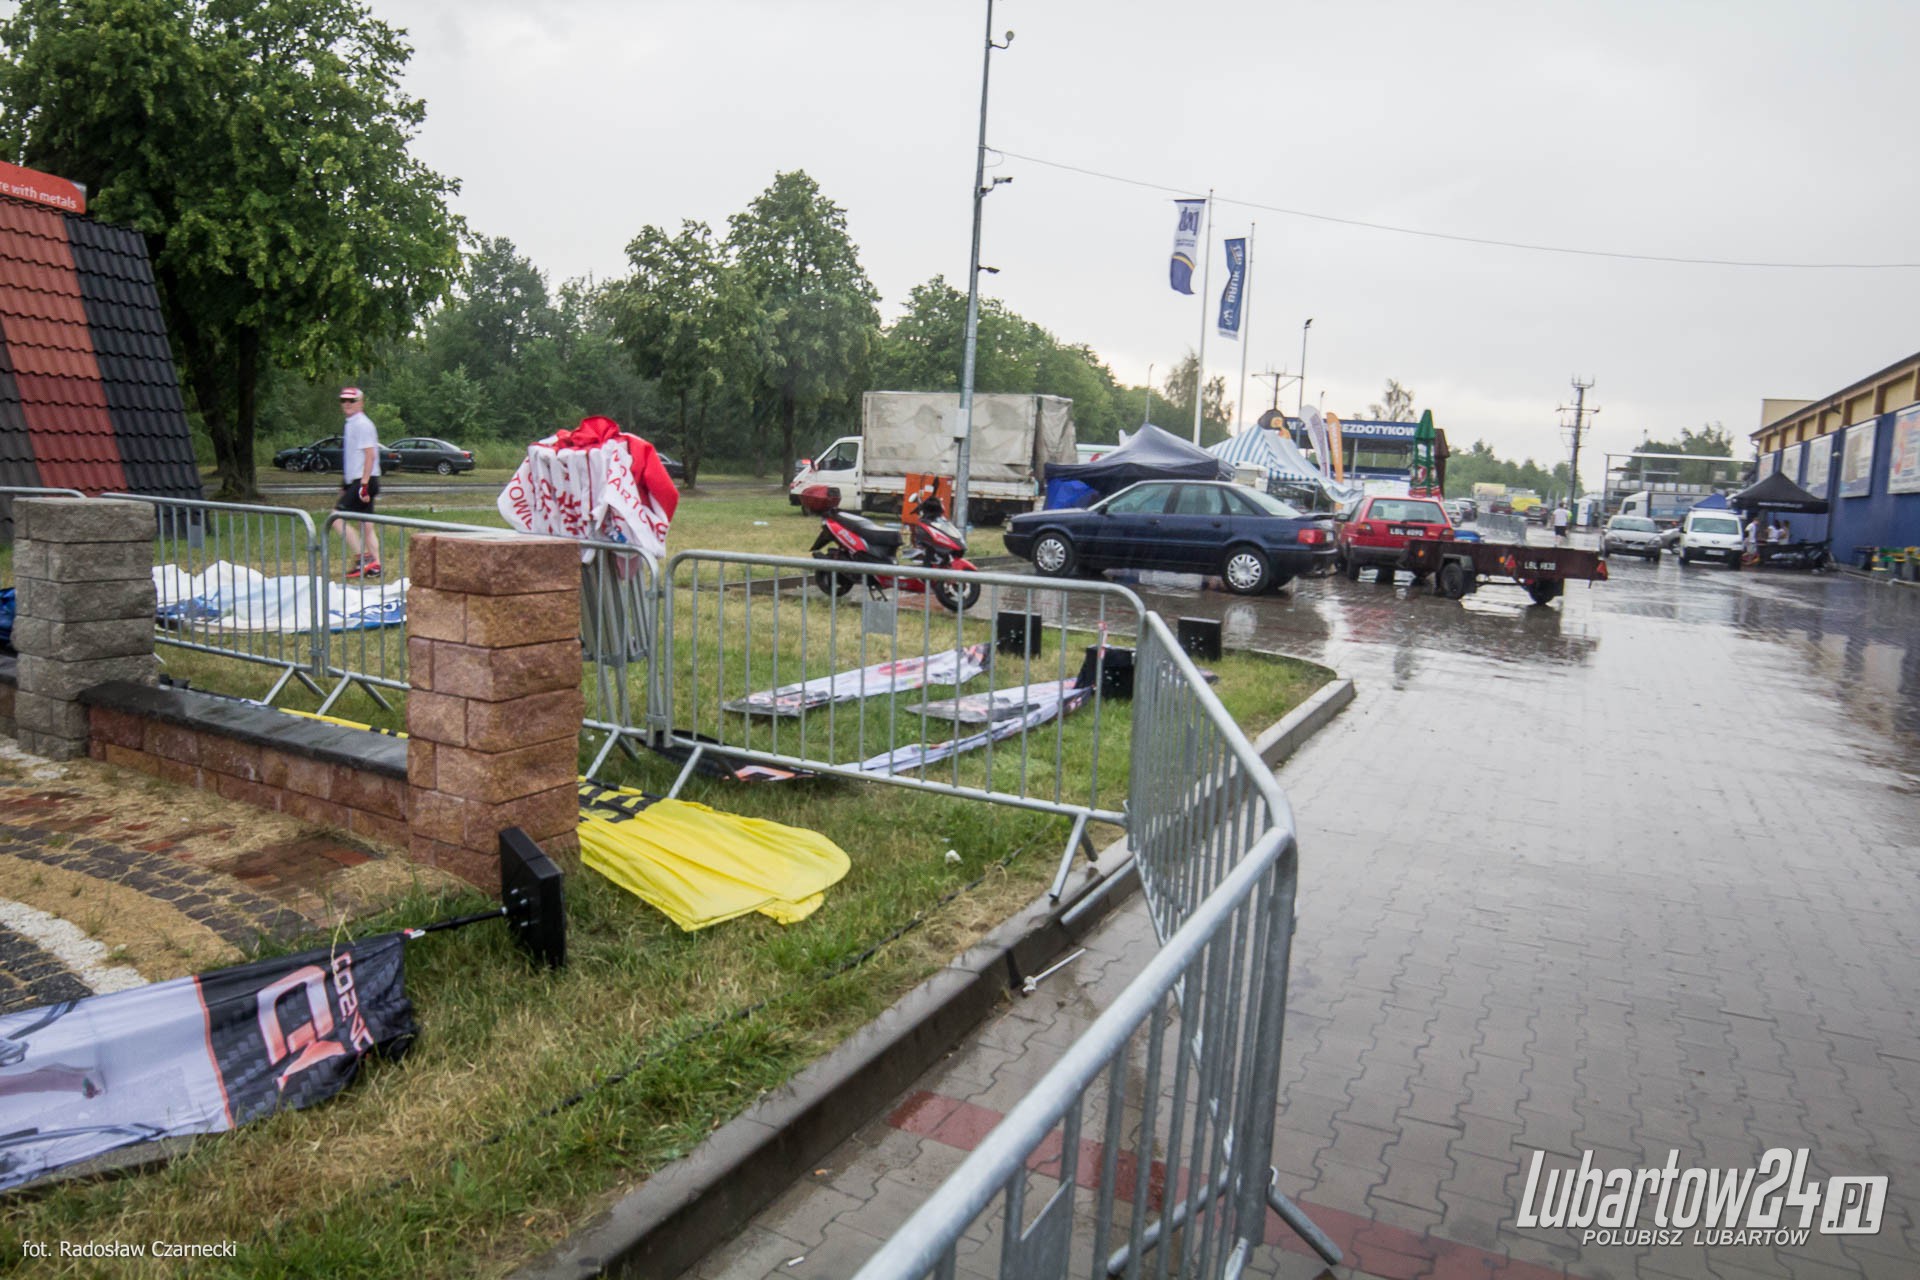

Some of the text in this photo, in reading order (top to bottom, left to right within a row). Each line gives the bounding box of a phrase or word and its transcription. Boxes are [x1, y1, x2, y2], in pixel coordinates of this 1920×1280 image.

[12, 184, 37, 199] with
[40, 191, 77, 209] metals
[1340, 423, 1416, 436] EZDOTYKOW
